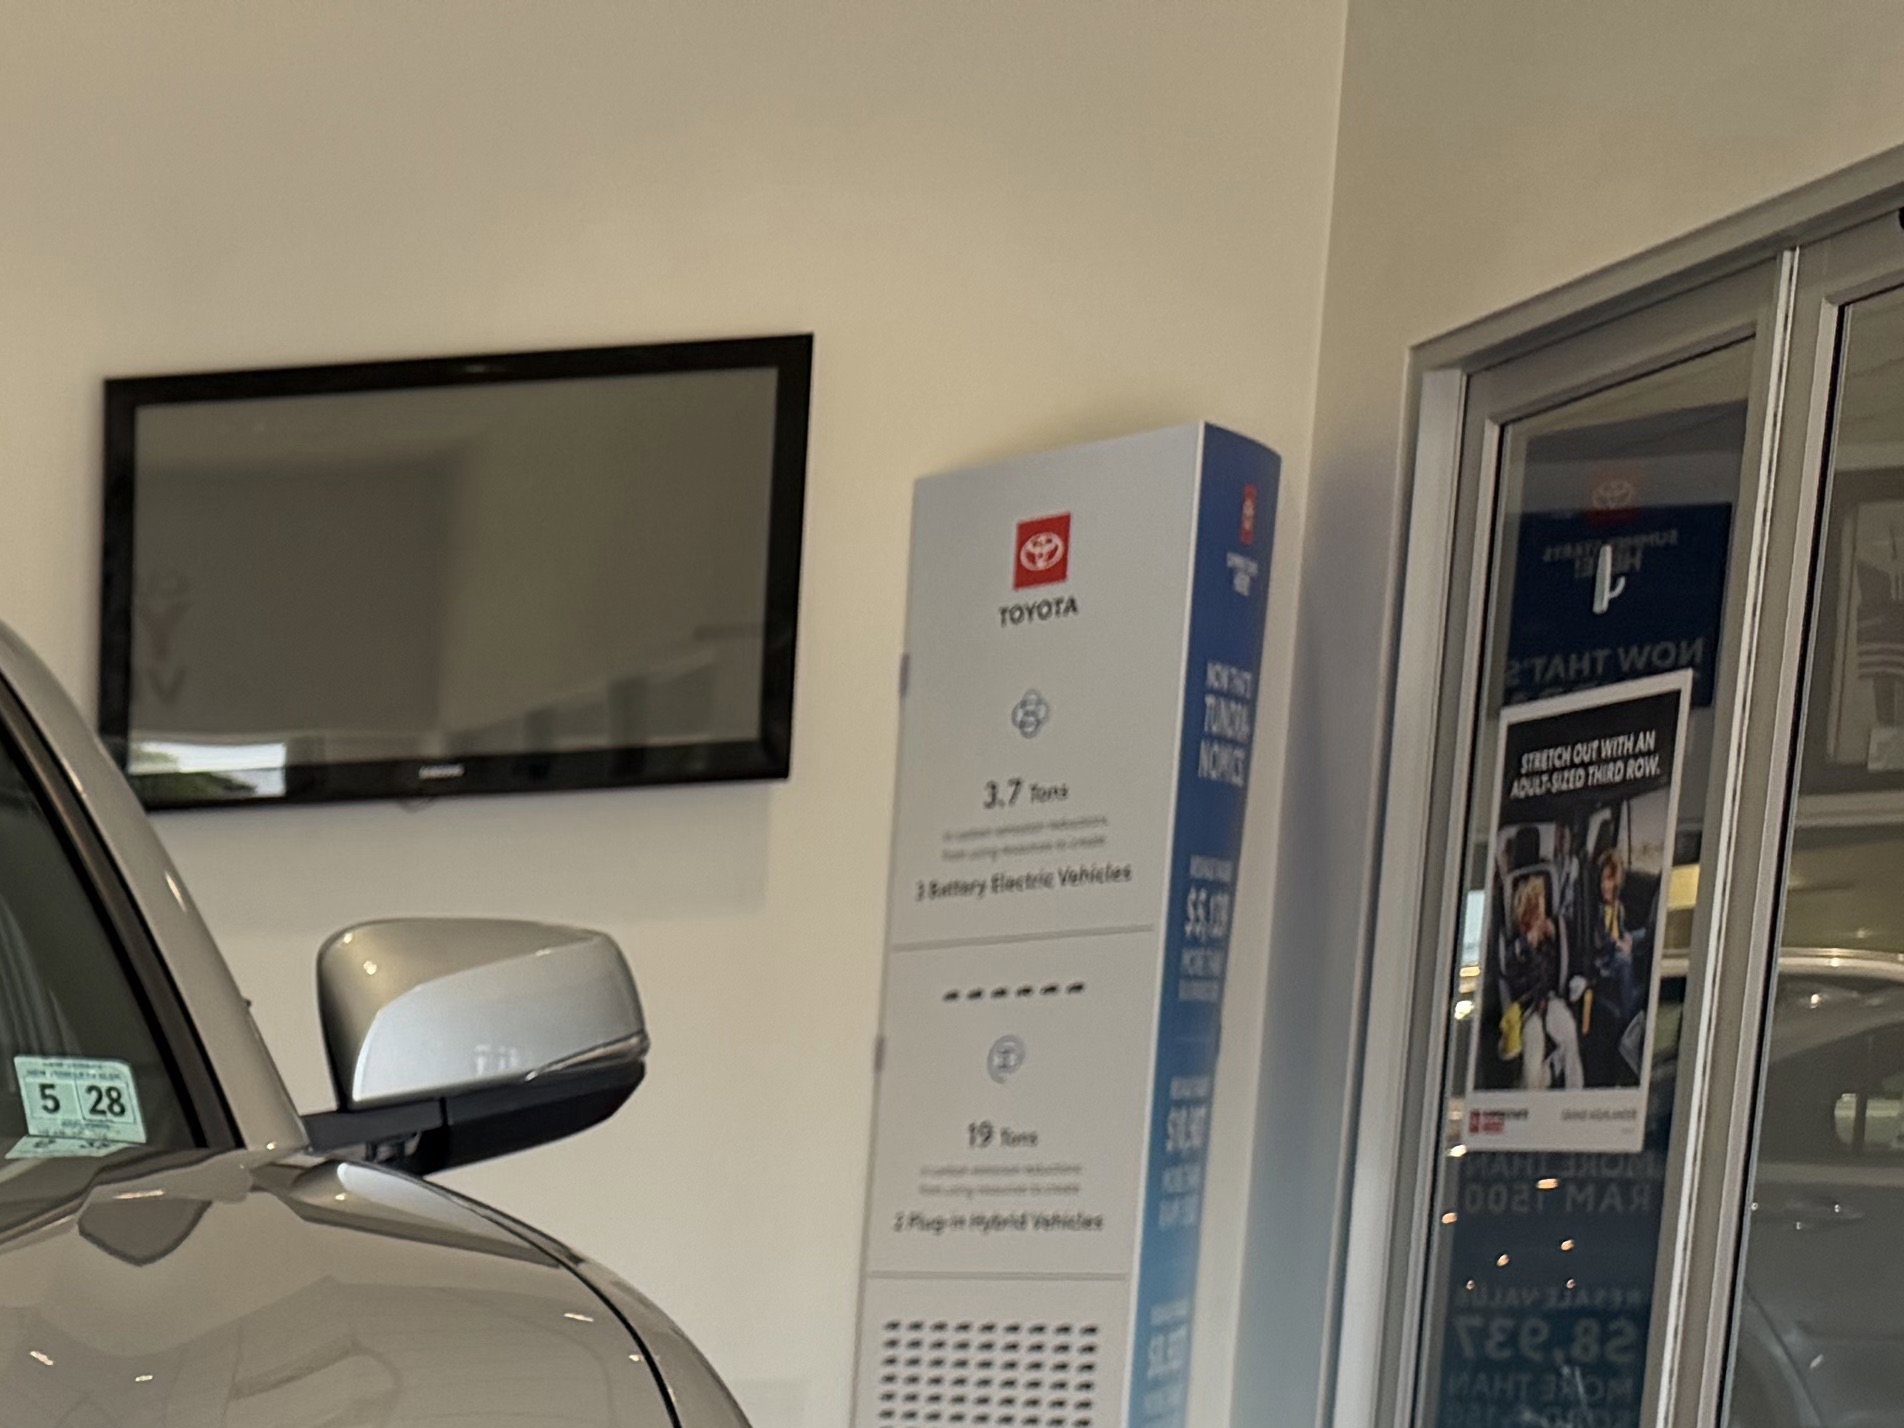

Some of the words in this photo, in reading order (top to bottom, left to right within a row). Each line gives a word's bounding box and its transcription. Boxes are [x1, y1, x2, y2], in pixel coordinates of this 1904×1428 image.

[999, 597, 1079, 627] TOYOTA
[1521, 745, 1571, 773] STRETCH
[1573, 740, 1600, 762] OUT
[1601, 732, 1635, 758] WITH
[1635, 730, 1656, 754] AN
[1510, 771, 1585, 798] ADULT-SIZED
[1588, 761, 1624, 786] THIRD
[1626, 754, 1660, 779] ROW.
[984, 778, 1023, 809] 3.7
[1029, 783, 1069, 803] Tons
[929, 879, 986, 899] Battery
[991, 871, 1055, 893] Electric
[1058, 863, 1132, 886] Vehicles
[39, 1083, 61, 1114] 5
[85, 1085, 125, 1117] 28
[968, 1120, 994, 1148] 19
[1033, 1212, 1103, 1231] Vehicles
